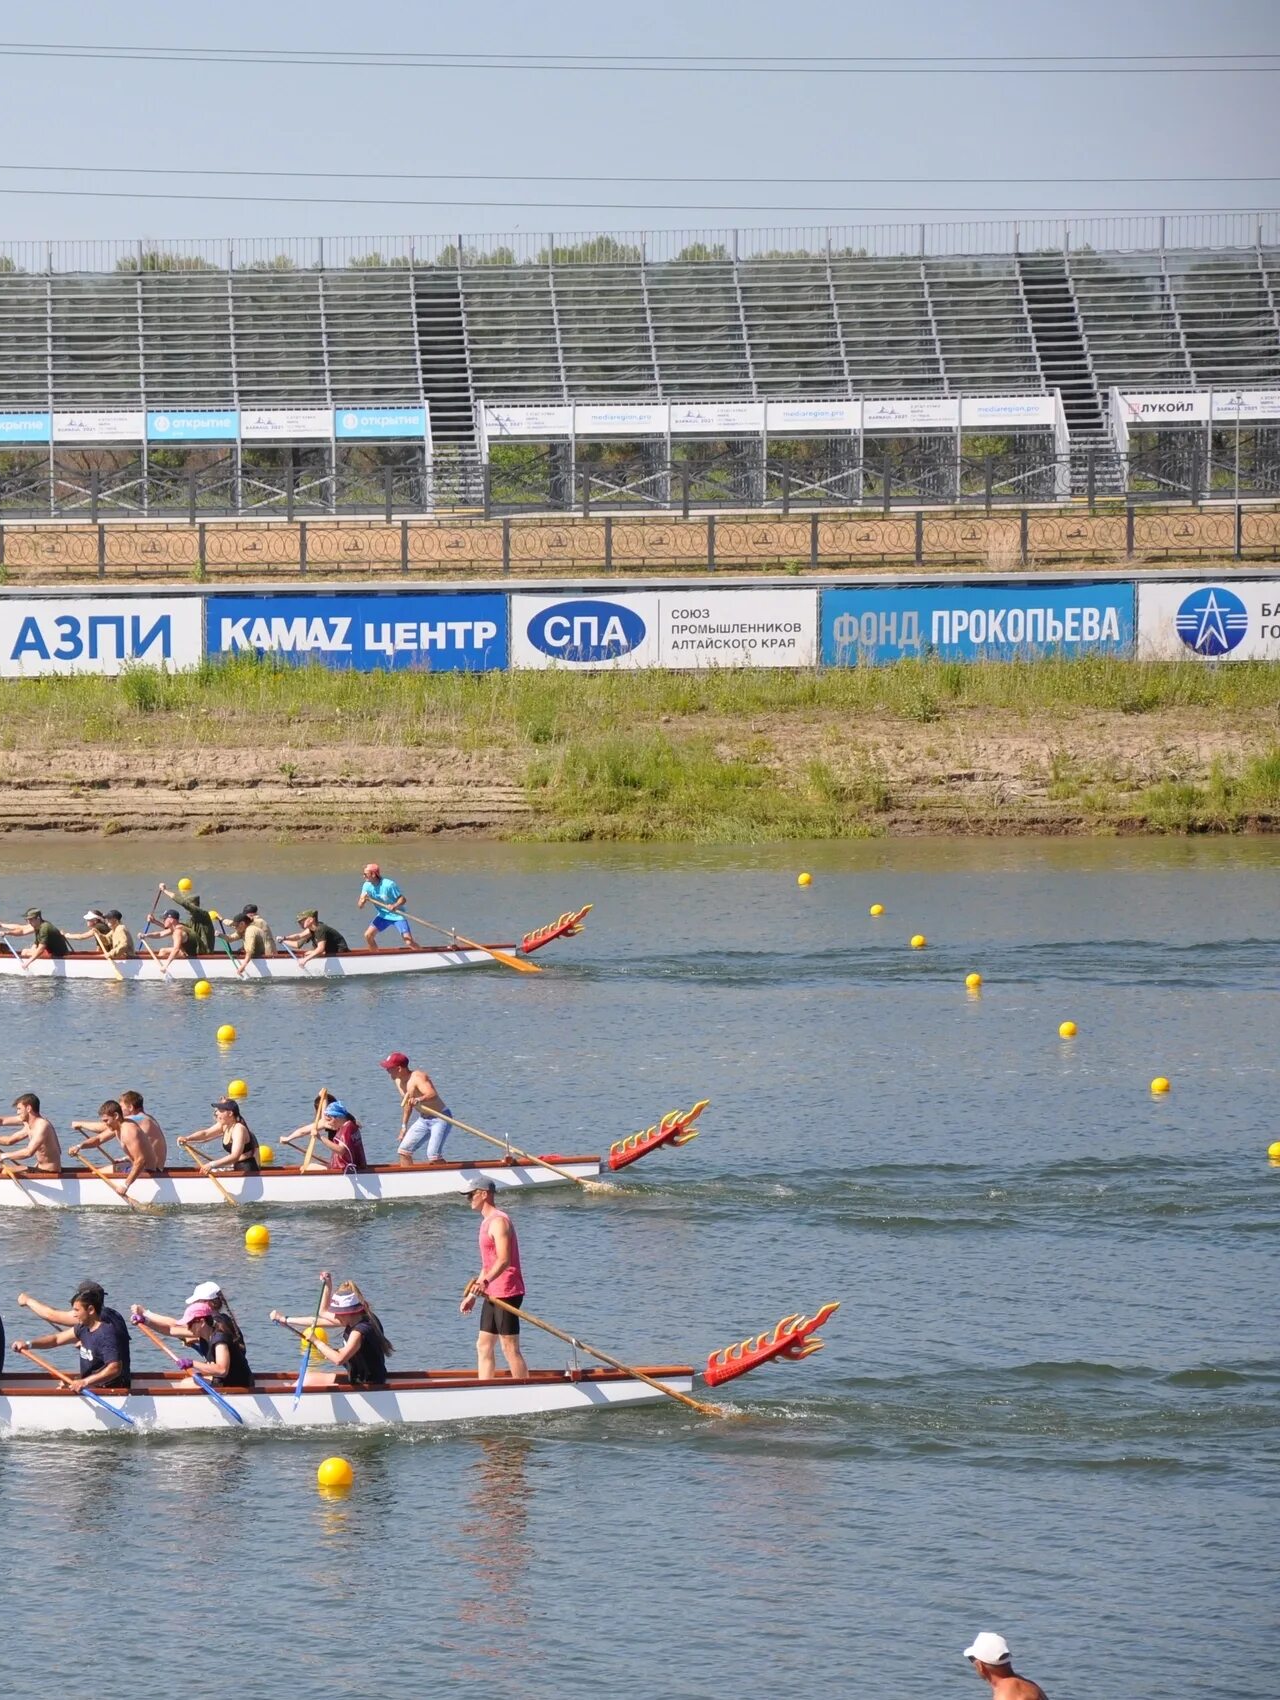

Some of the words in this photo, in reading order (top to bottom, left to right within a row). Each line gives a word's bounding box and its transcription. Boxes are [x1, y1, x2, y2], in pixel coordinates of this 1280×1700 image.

[1140, 401, 1194, 413] ЛУКОЙЛ
[172, 418, 232, 430] открытие
[360, 415, 420, 428] открытие
[671, 608, 710, 619] СОЮЗ
[543, 616, 629, 648] СПА
[671, 622, 802, 635] ПРОМЫШЛЕННИКОВ
[833, 611, 919, 648] ФОНД
[931, 606, 1120, 645] ПРОКОПЬЕВА
[10, 614, 172, 660] АЗПИ
[220, 617, 352, 651] KAMAZ
[364, 621, 497, 656] ЦЕНТР
[671, 637, 759, 650] АЛТАЙСКОГО
[761, 638, 796, 649] КРАЯ
